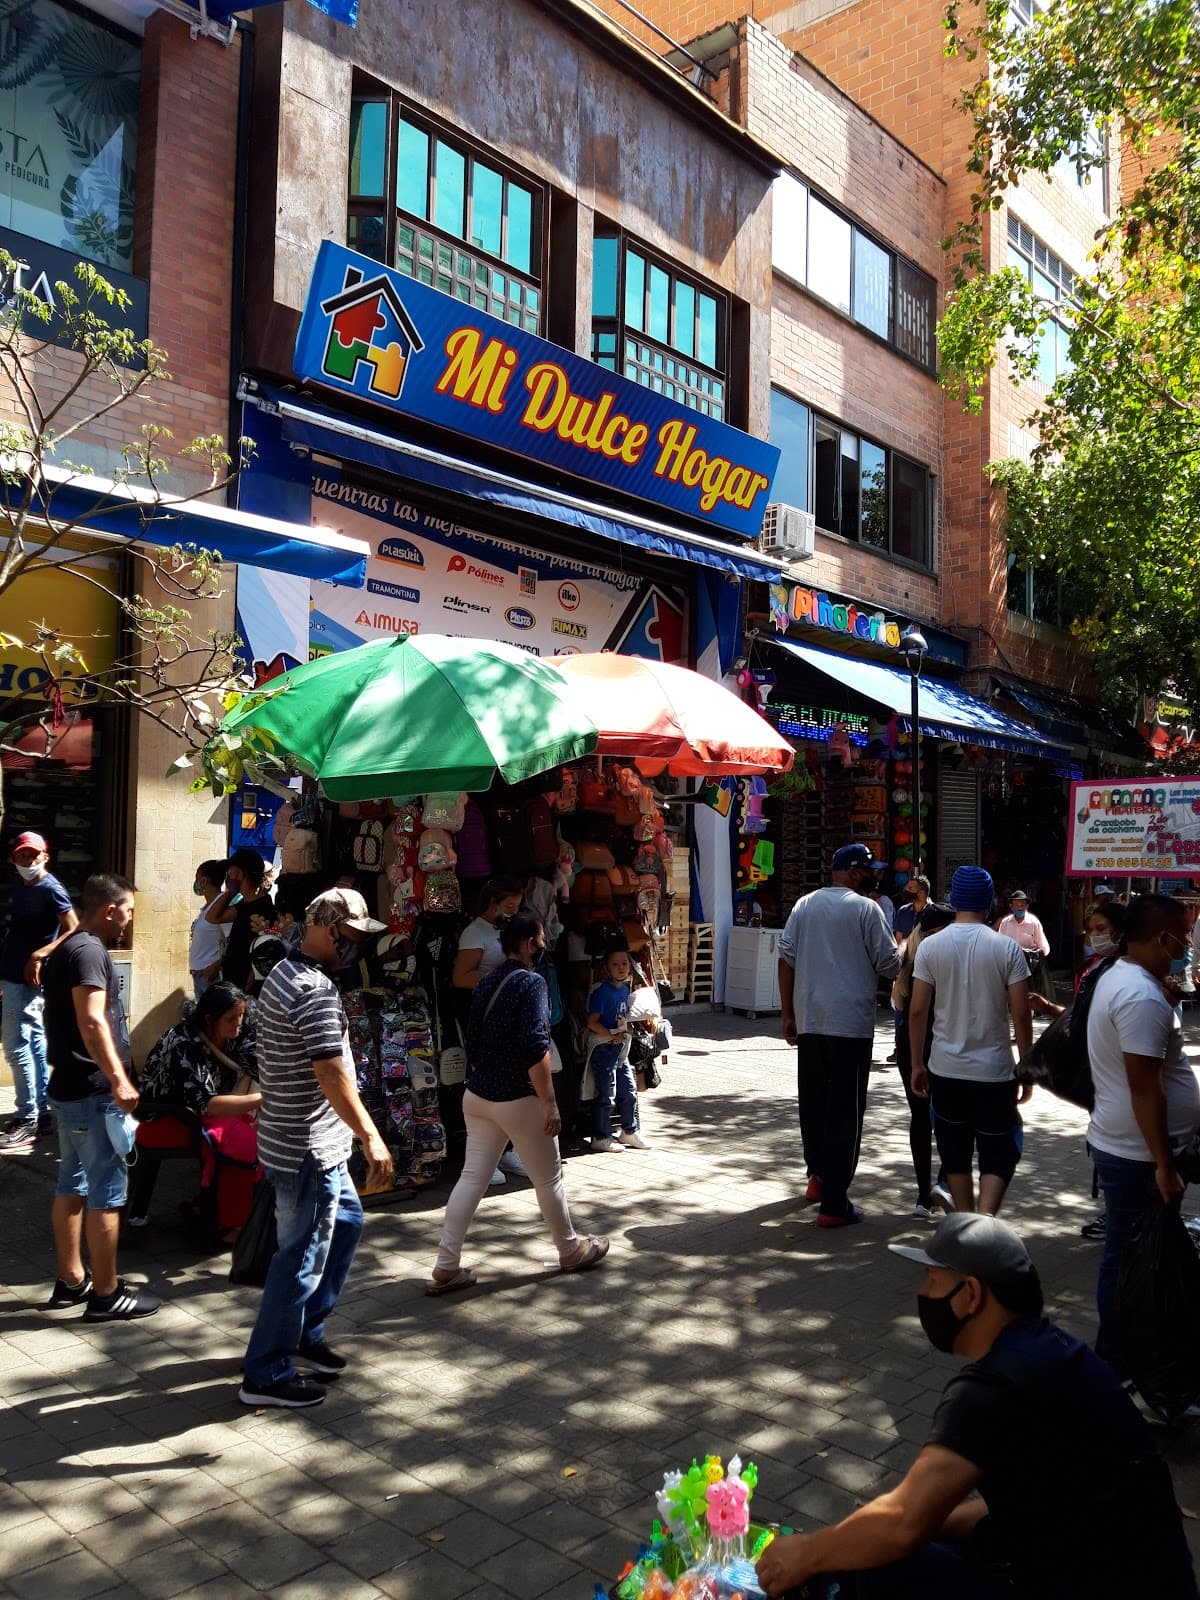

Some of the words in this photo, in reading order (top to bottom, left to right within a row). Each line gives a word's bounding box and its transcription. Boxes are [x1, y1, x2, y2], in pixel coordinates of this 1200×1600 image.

[5, 161, 50, 189] PEDICURA
[434, 325, 519, 415] Mi
[520, 361, 649, 466] Dulce
[653, 417, 769, 514] Hogar
[467, 564, 505, 584] Pólines
[371, 582, 417, 600] TRAMONTINA
[562, 589, 577, 602] ilko
[443, 596, 491, 614] plinsa
[553, 620, 586, 637] RIMAX
[1089, 788, 1167, 809] TITANIC
[1088, 826, 1100, 834] de
[1094, 818, 1136, 827] Carabobo
